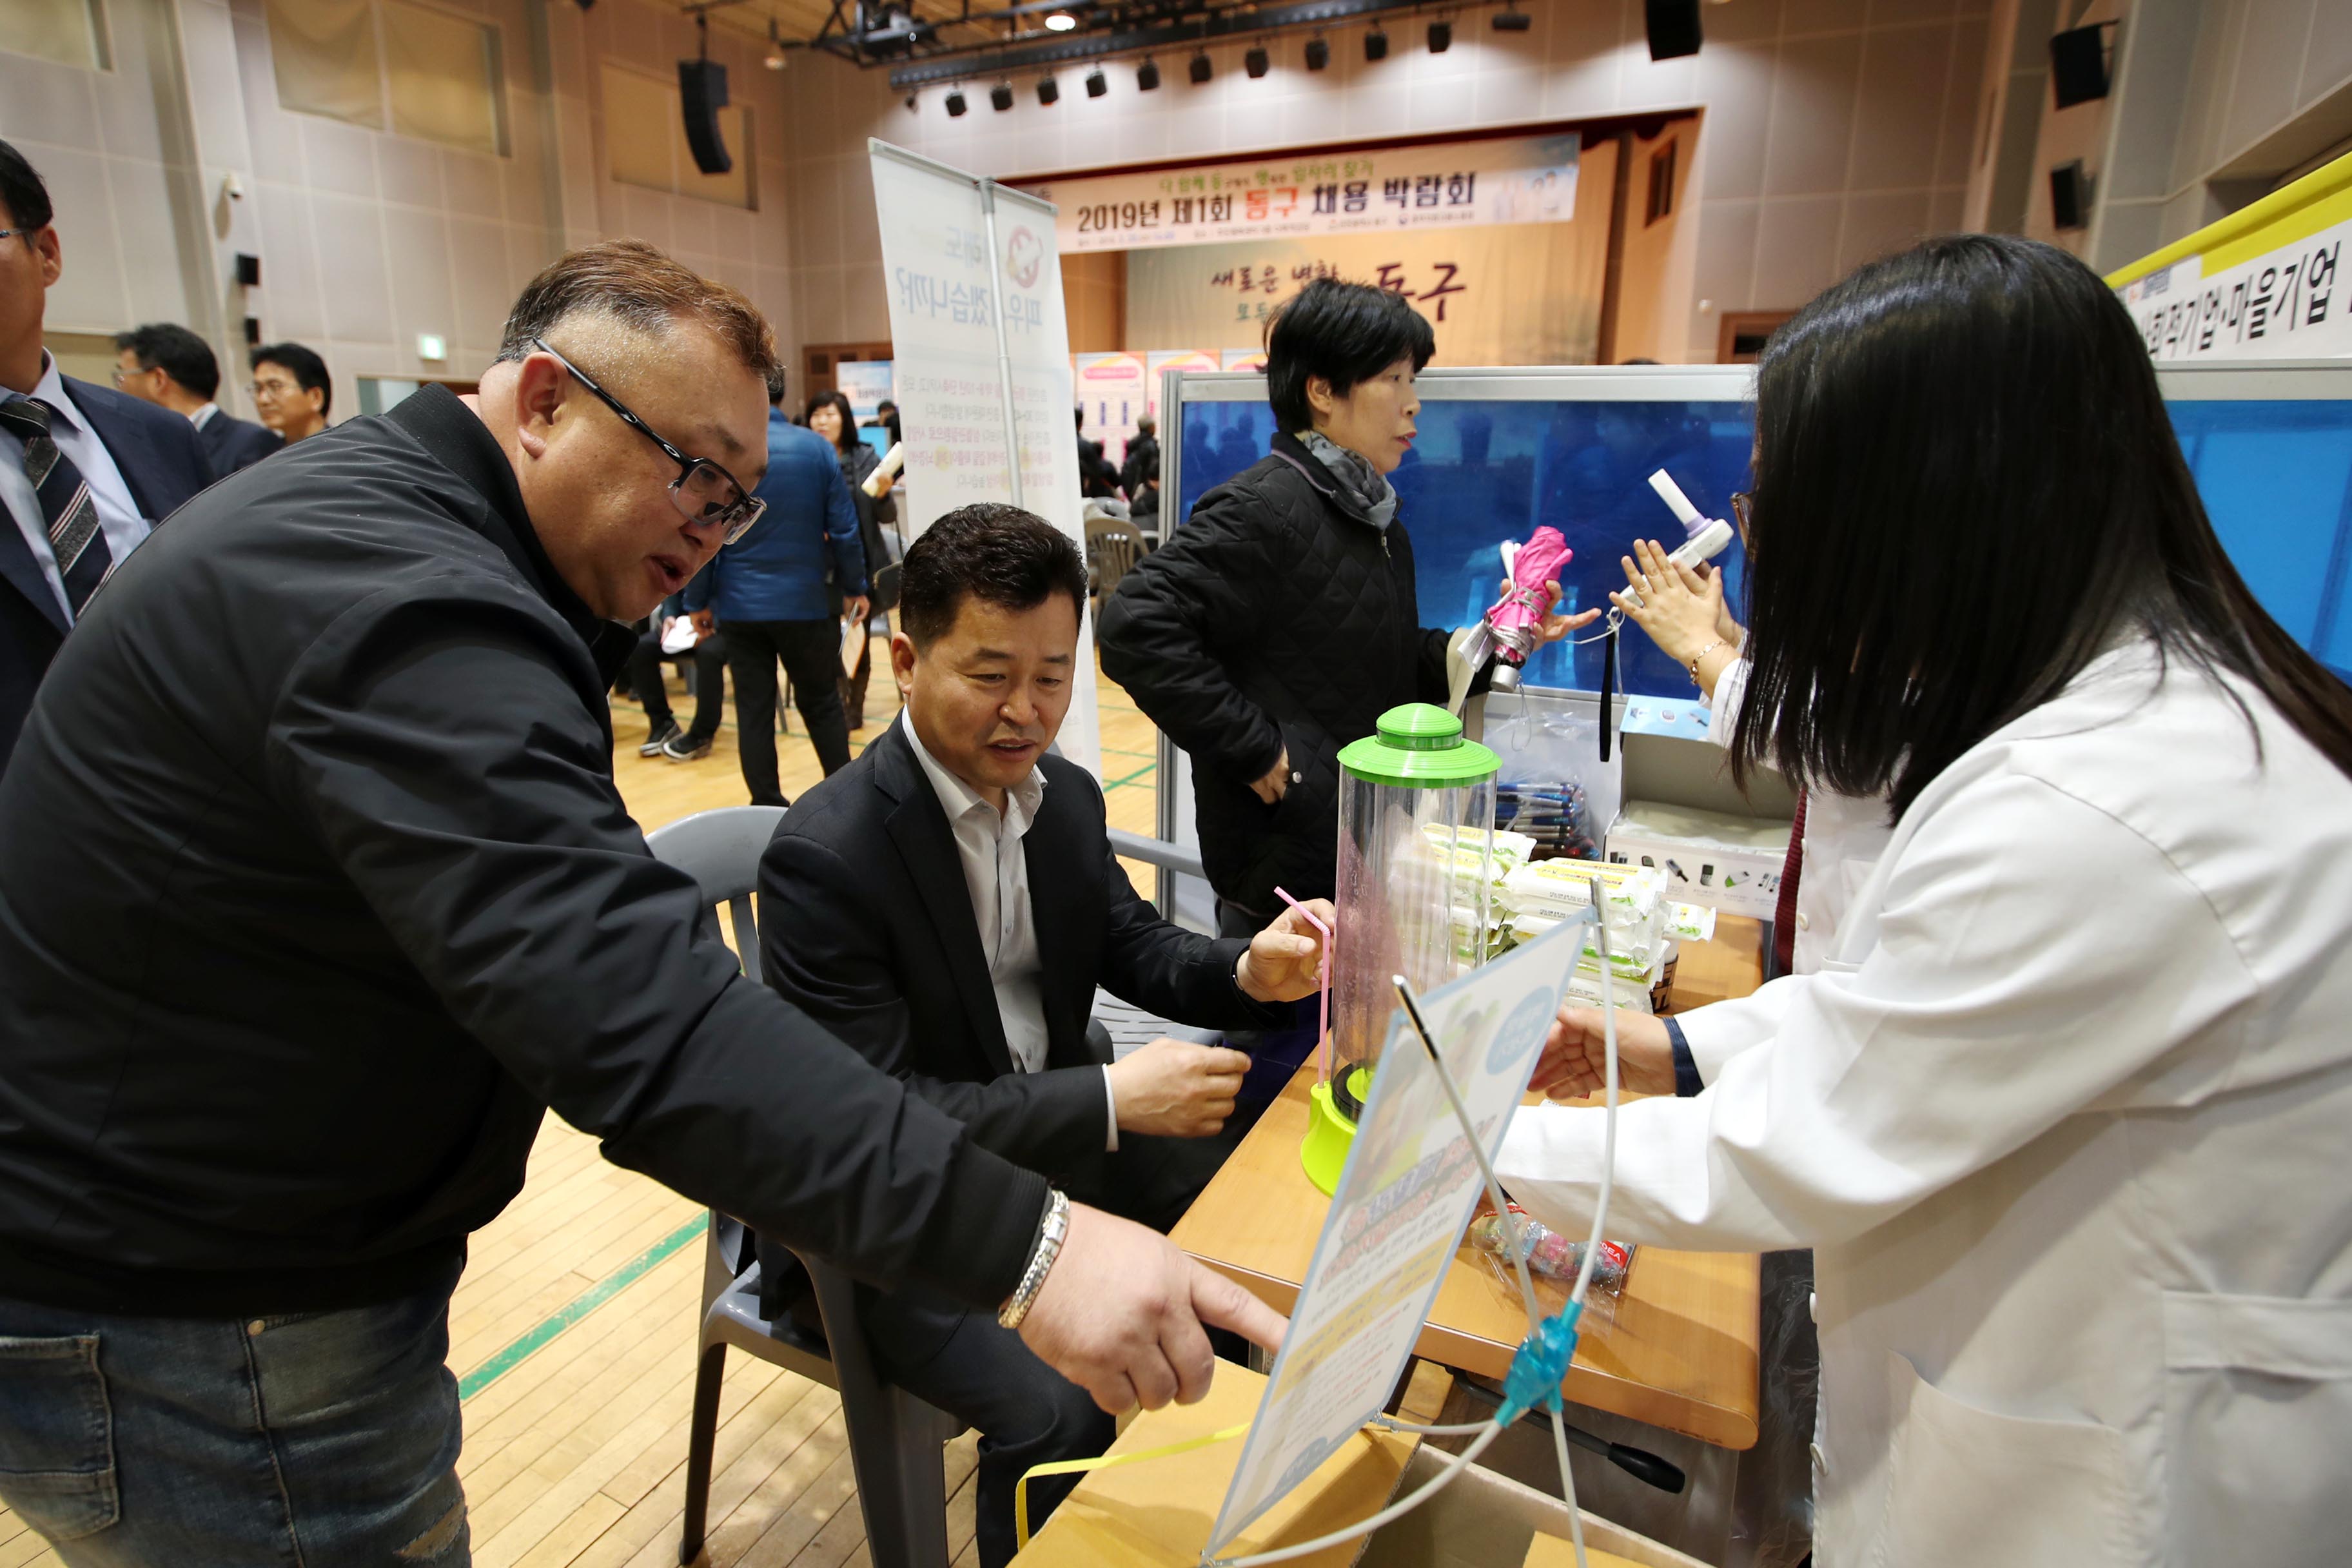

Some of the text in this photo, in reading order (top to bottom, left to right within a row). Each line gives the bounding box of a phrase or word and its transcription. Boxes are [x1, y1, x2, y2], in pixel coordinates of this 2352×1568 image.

[1078, 199, 1160, 233] 2019년
[1172, 193, 1233, 224] 제1회
[1246, 186, 1298, 220] 동구
[1313, 180, 1369, 214] 채용
[1384, 171, 1476, 208] 박람회
[1211, 266, 1279, 293] 새로운
